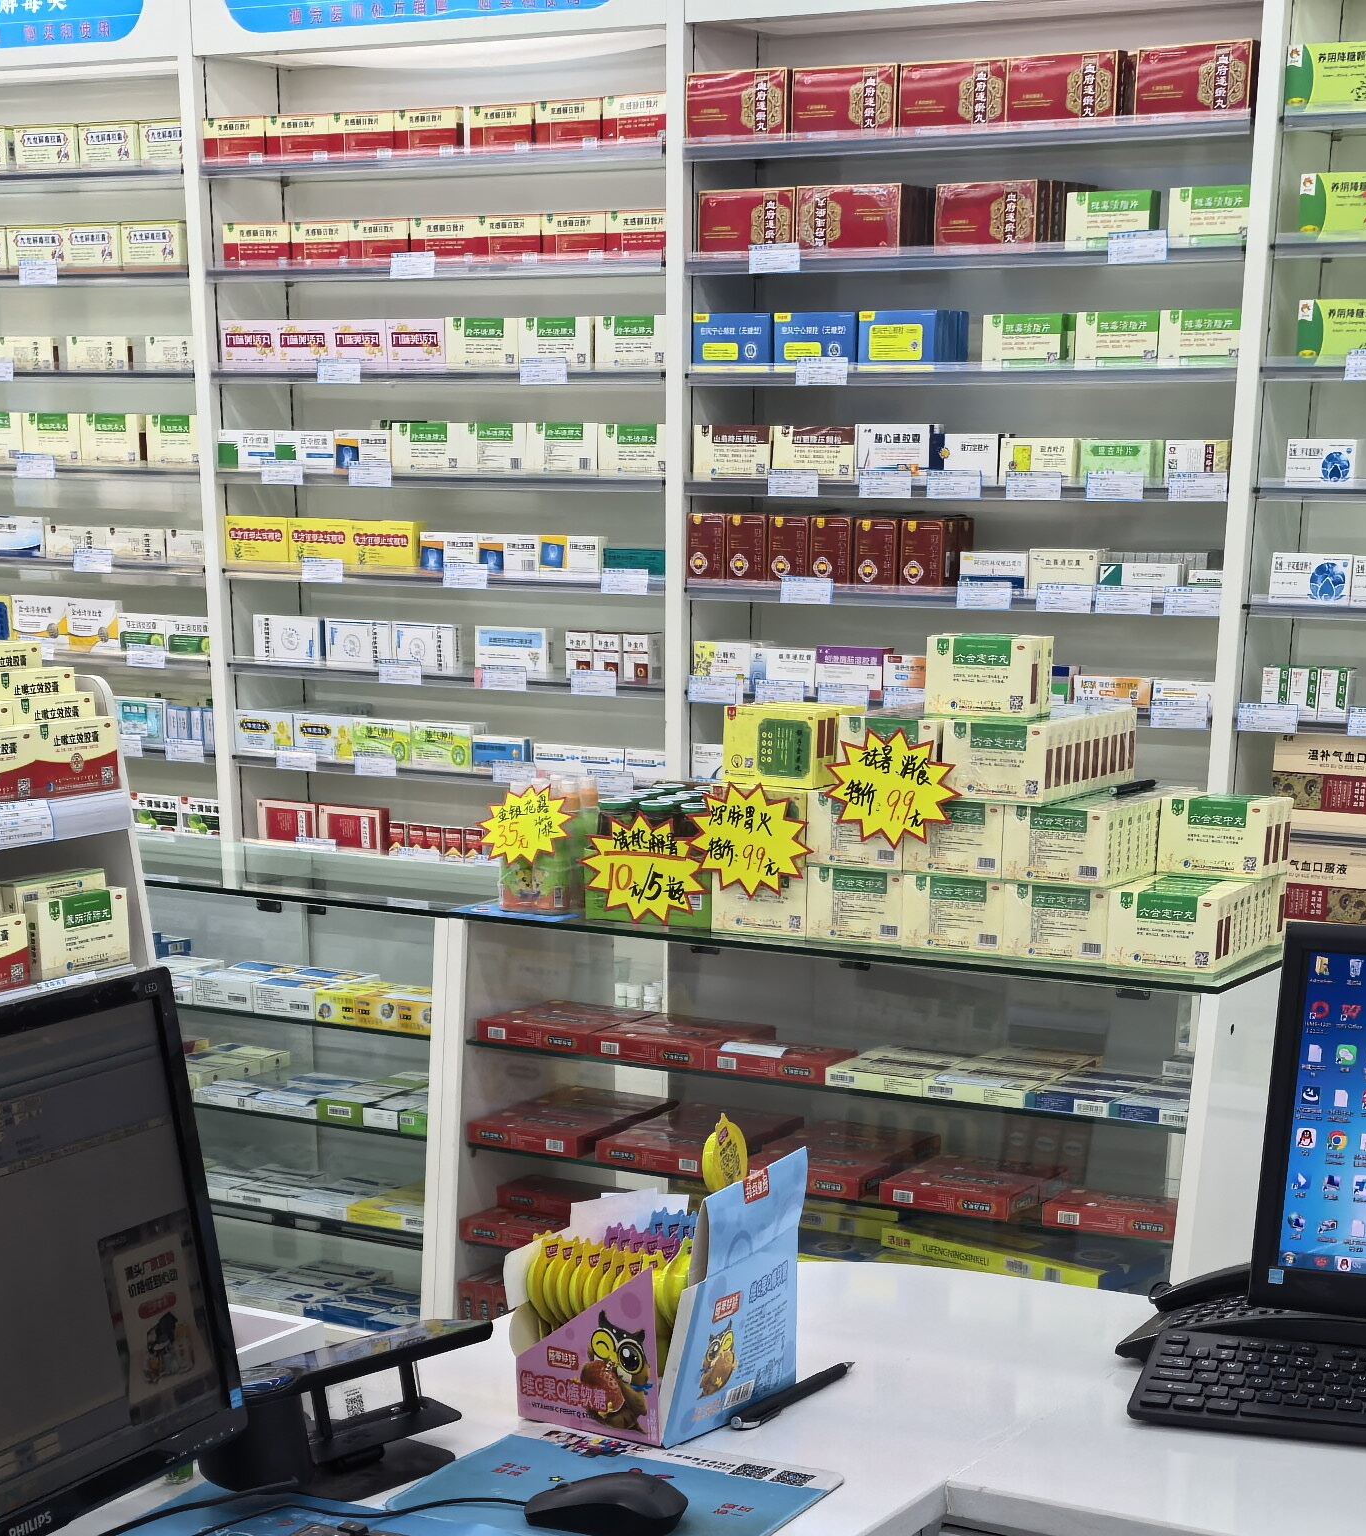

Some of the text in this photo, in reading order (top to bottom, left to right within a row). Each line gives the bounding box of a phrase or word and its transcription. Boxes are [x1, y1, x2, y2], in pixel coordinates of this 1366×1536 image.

[1214, 54, 1230, 110] 血府逐瘀丸
[975, 71, 987, 124] 血府逐瘀丸
[1083, 64, 1096, 118] 血府逐瘀丸
[864, 76, 877, 128] 血府逐瘀丸
[1004, 191, 1017, 244] 血府逐瘀丸
[955, 653, 1009, 665] 六合定中丸
[14, 681, 59, 696] 止嗽立效胶囊
[34, 705, 79, 721] 止嗽立效胶囊
[971, 736, 1026, 749] 六合定中丸
[497, 794, 549, 823] 金银花露
[1033, 816, 1084, 828] 六合定中丸
[1190, 814, 1245, 826] 六合定中丸
[497, 821, 528, 849] 35元
[1290, 859, 1347, 875] 气血口服液
[608, 862, 685, 904] 10元/5瓶
[1036, 894, 1087, 906] 六合定中丸
[1139, 907, 1195, 921] 六合定中丸
